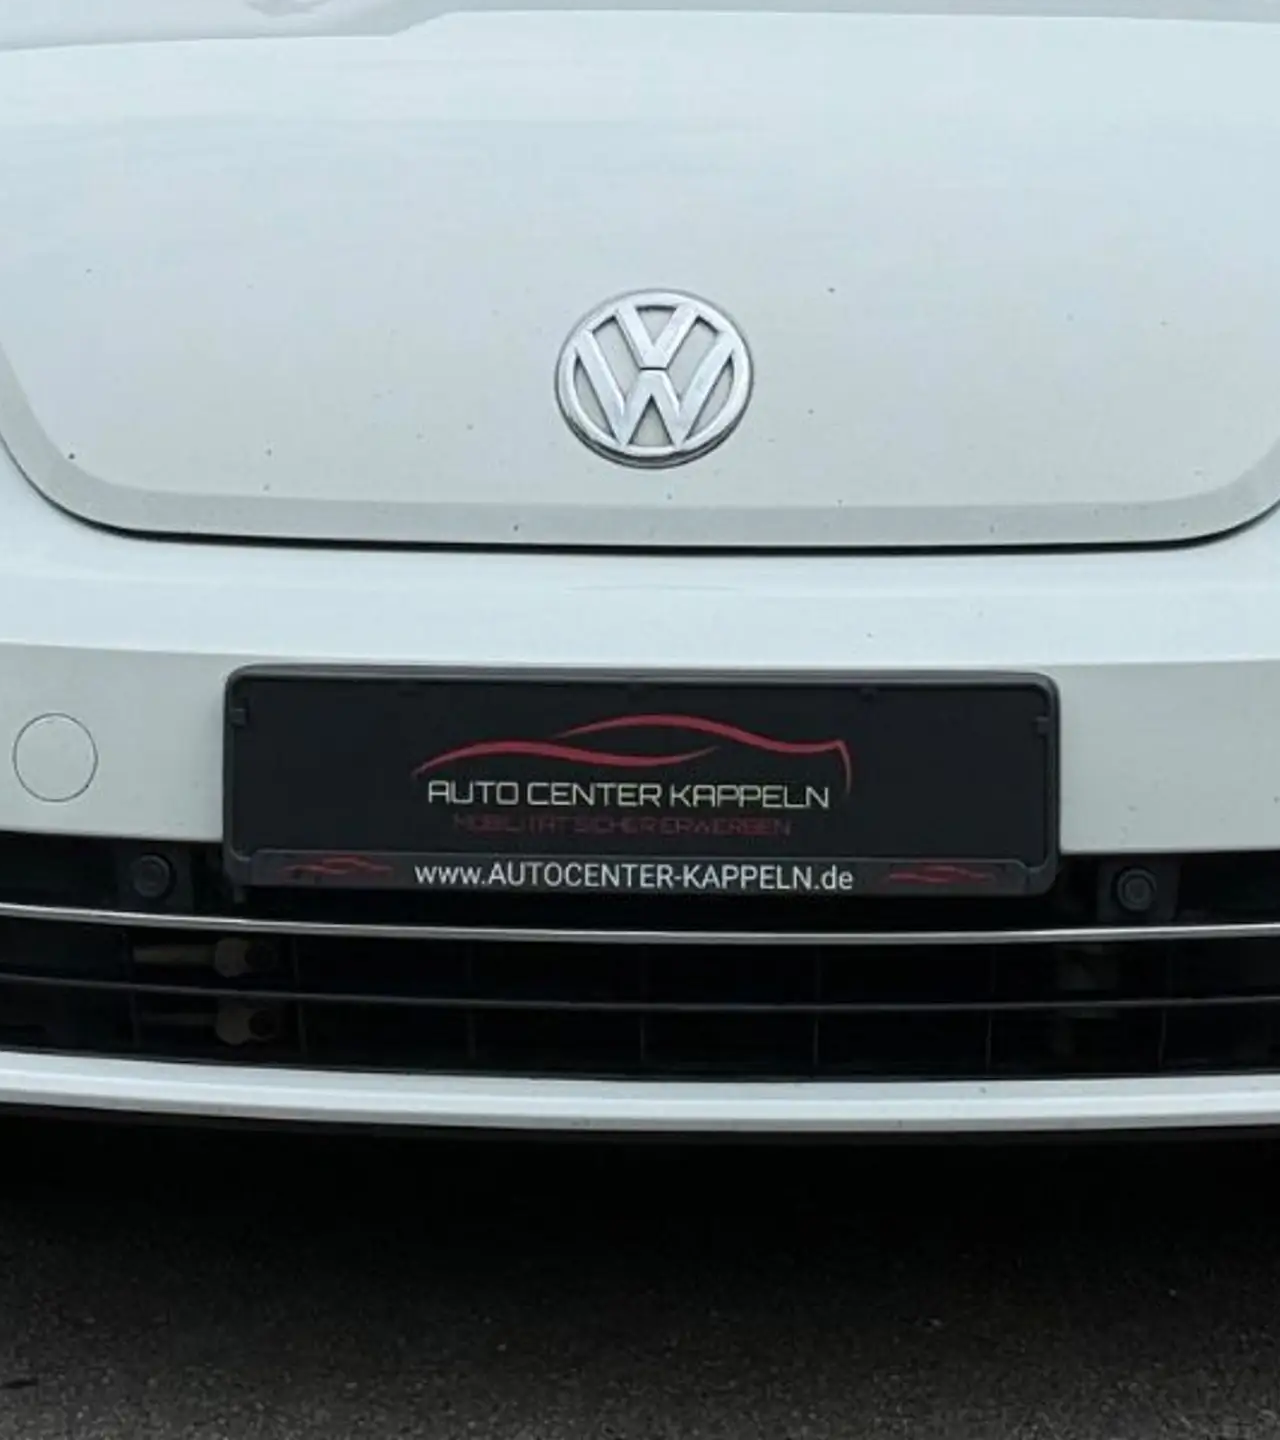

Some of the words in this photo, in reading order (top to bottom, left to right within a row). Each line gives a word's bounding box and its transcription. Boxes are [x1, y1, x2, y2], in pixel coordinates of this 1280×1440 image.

[562, 294, 748, 460] VW
[427, 780, 518, 805] AUTO
[527, 782, 661, 808] CENTER
[669, 785, 830, 809] KAPPELN
[414, 861, 854, 890] www.AUTOCENTER-KAPPELN.de
